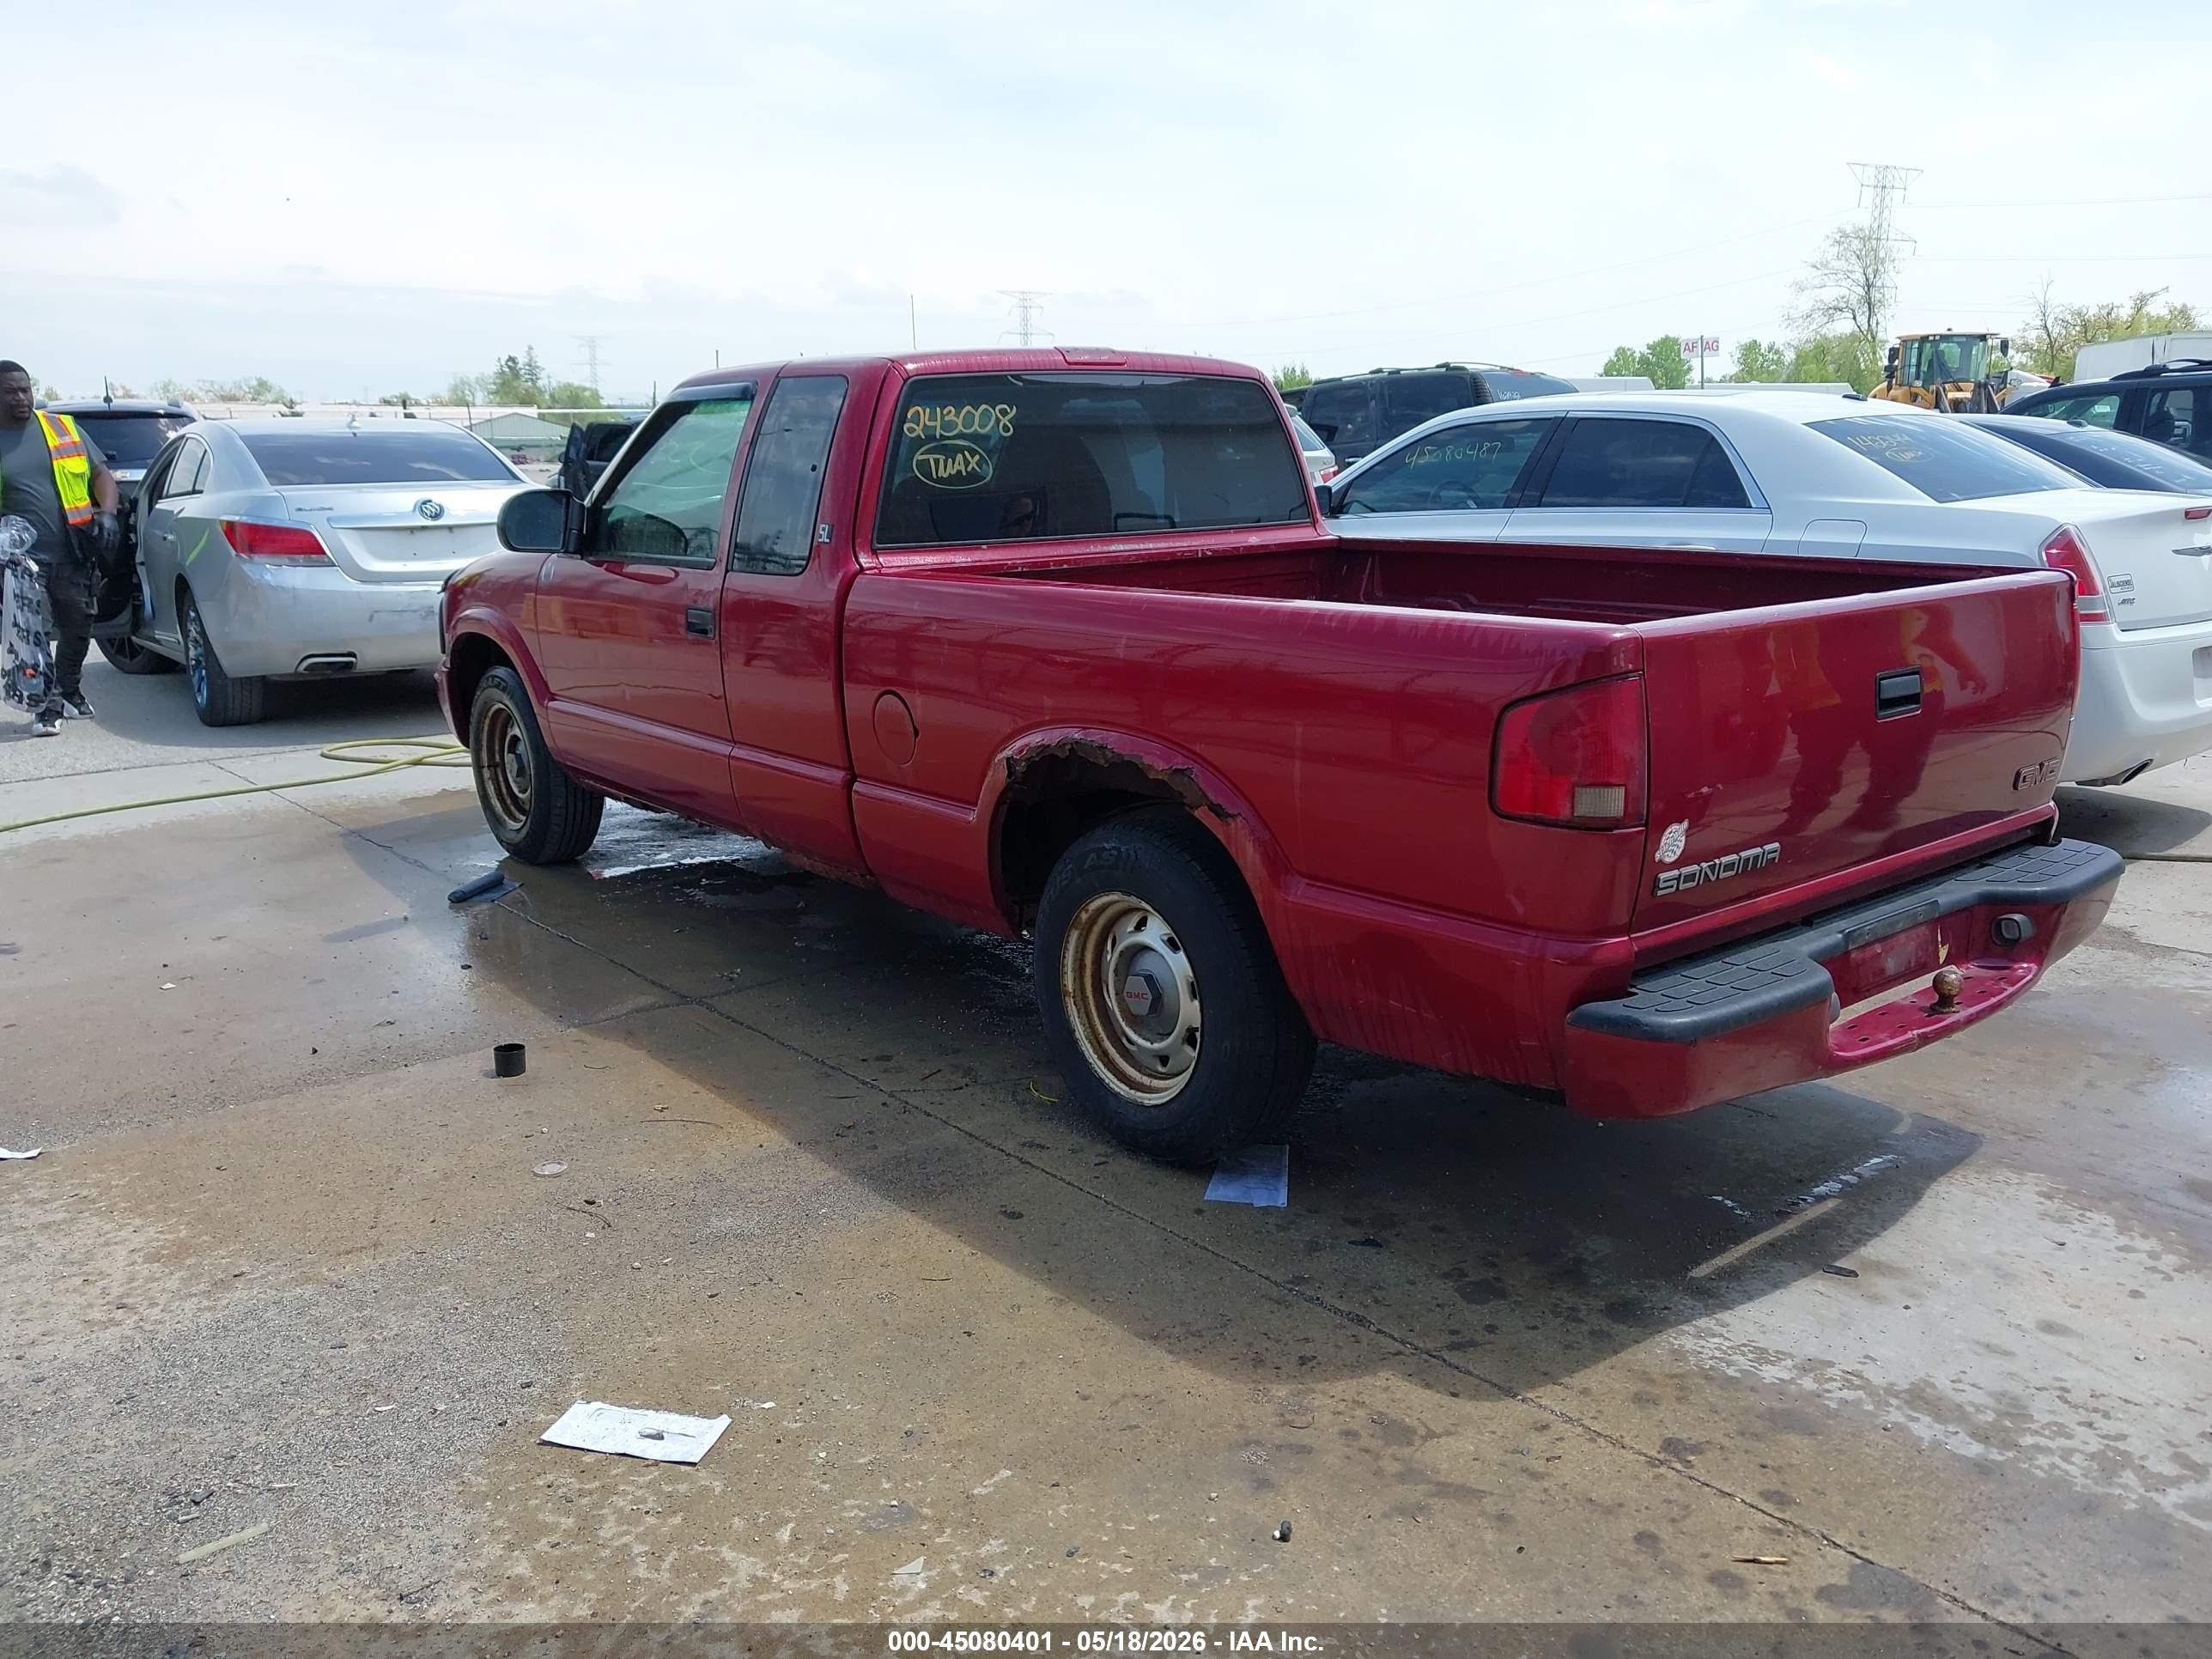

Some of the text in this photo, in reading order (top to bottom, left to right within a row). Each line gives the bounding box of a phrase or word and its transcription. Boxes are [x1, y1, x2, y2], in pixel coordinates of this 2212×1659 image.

[902, 404, 1017, 439] 243008
[817, 524, 830, 543] SL
[1654, 842, 1781, 896] SONOMA
[1126, 991, 1149, 1000] GMC
